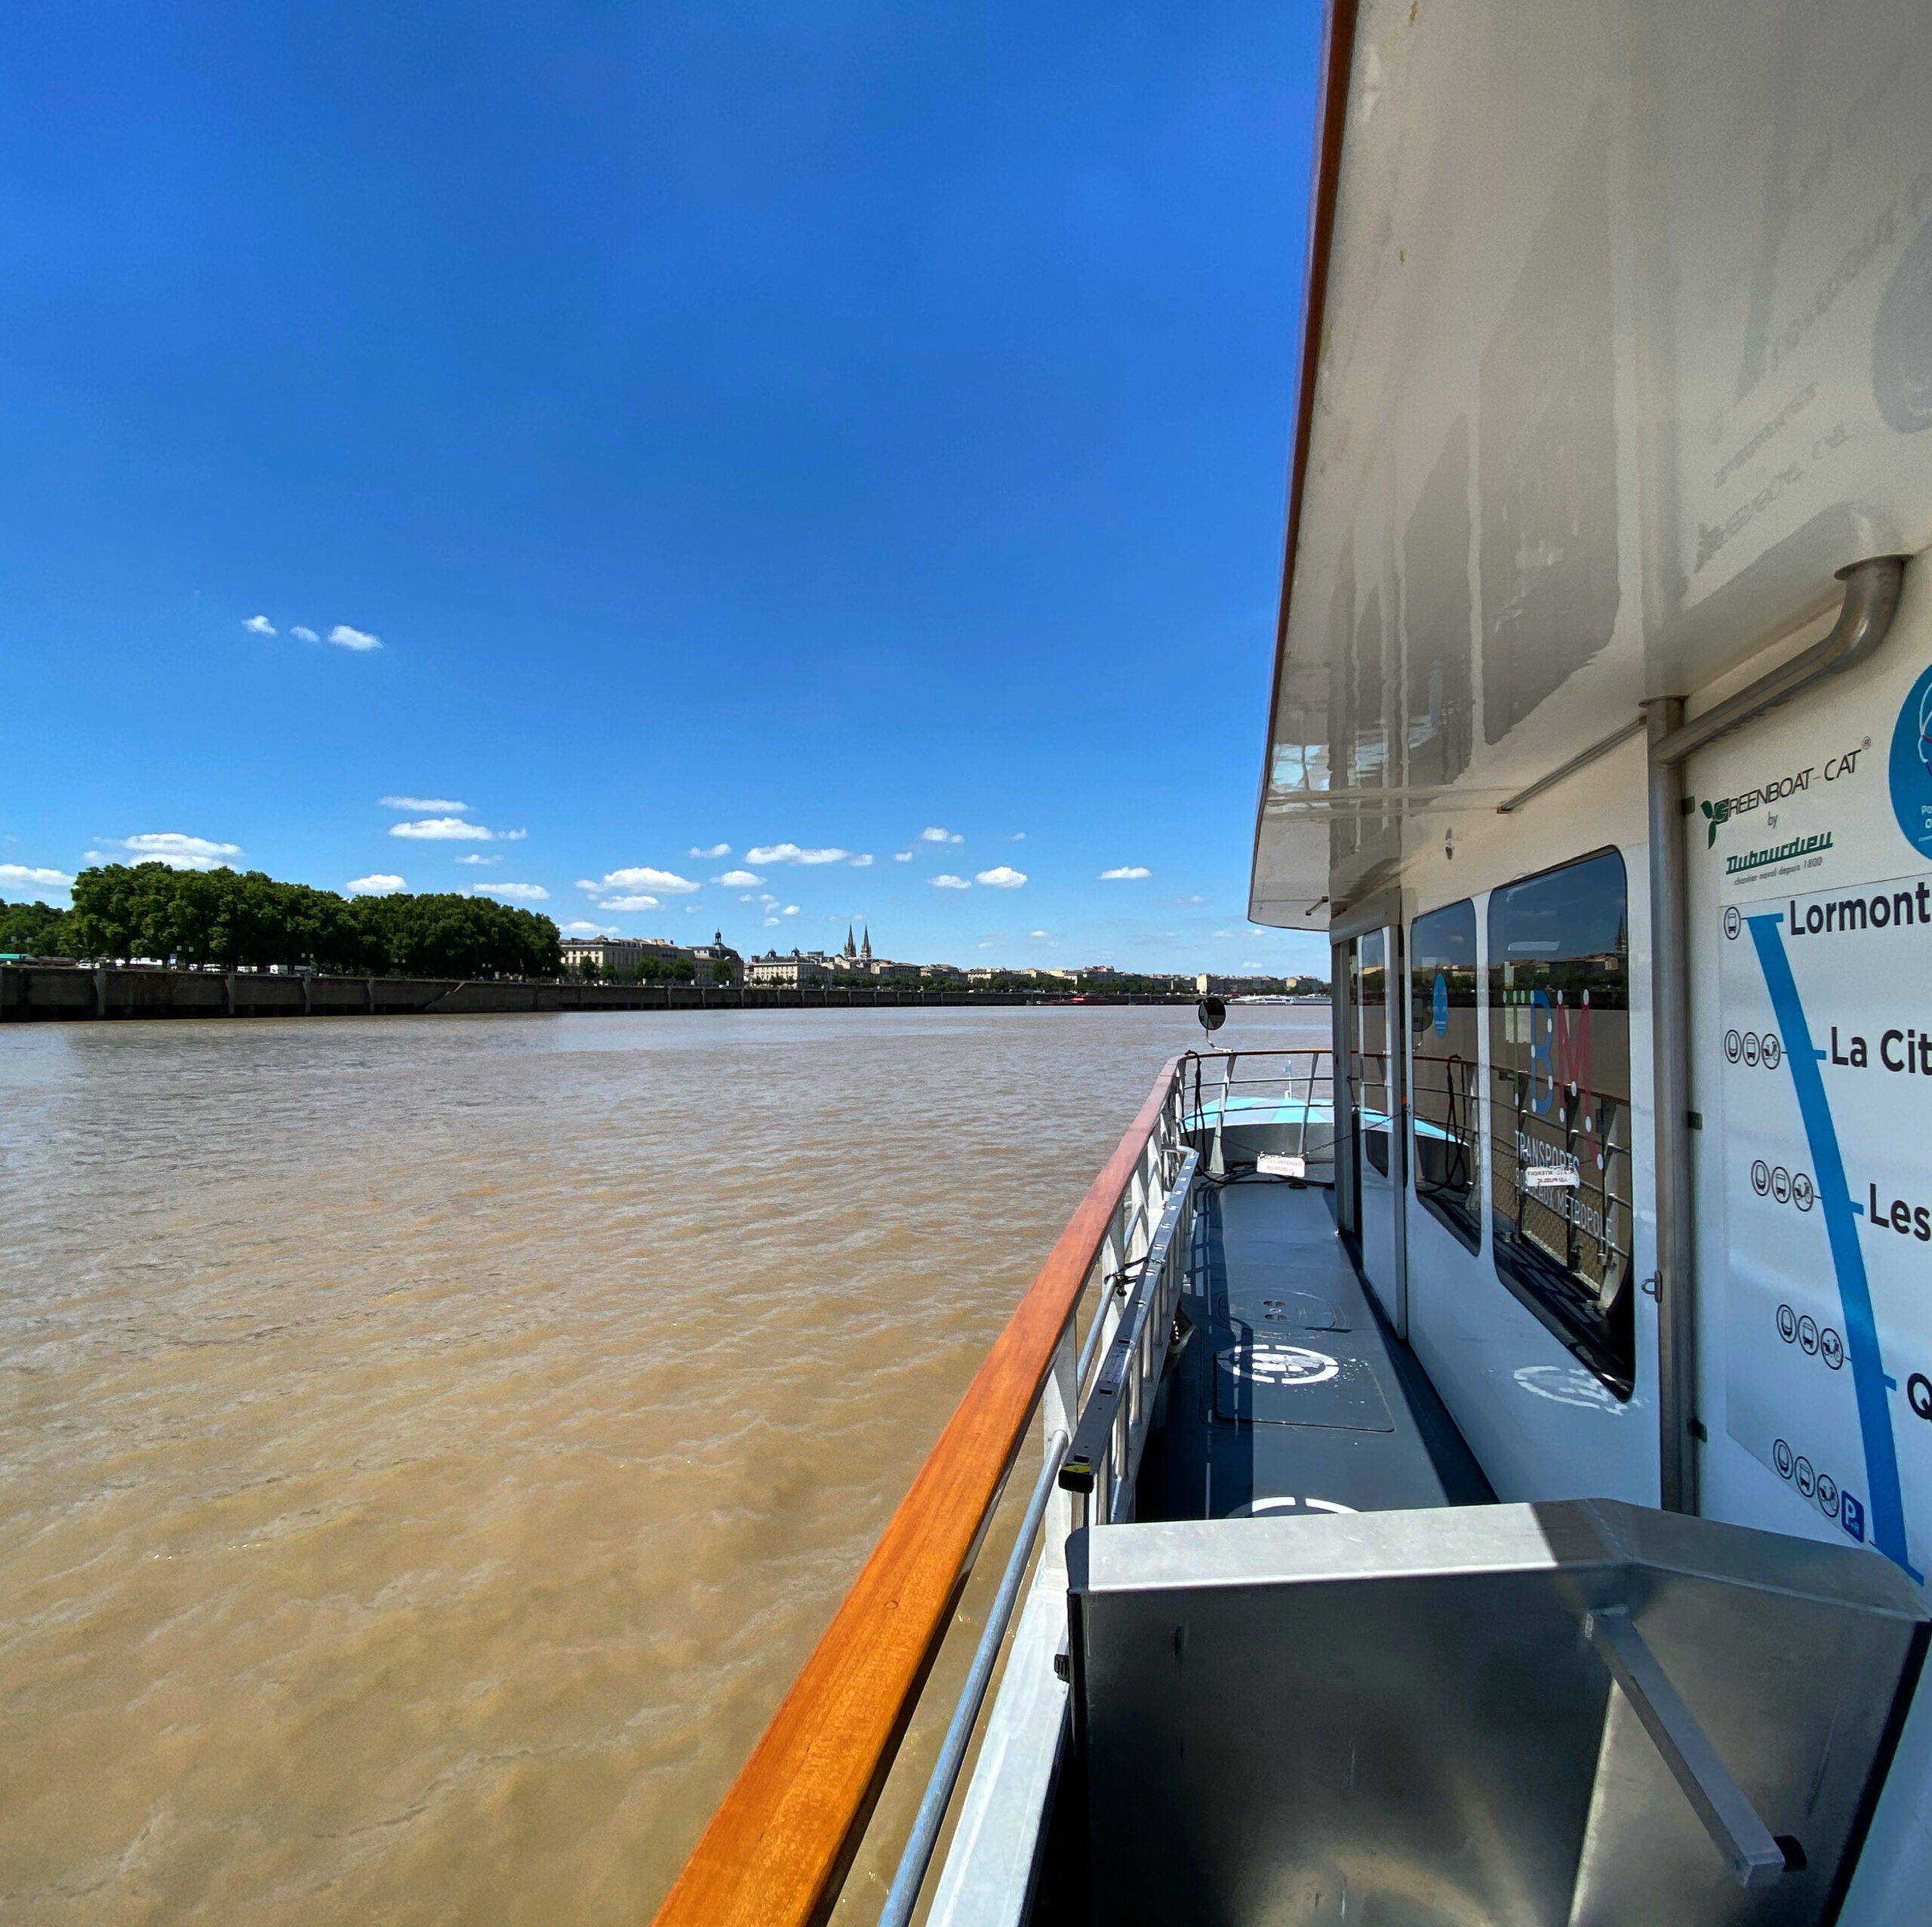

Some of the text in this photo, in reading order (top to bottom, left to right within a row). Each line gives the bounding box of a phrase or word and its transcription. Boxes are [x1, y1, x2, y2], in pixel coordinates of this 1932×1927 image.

[1767, 811, 1779, 829] by
[1759, 868, 1777, 879] naval
[1778, 863, 1801, 876] depuis
[1803, 856, 1823, 870] 1800
[1790, 882, 1931, 936] Lormont
[1831, 1027, 1932, 1076] La Cit
[1869, 1182, 1931, 1242] Les
